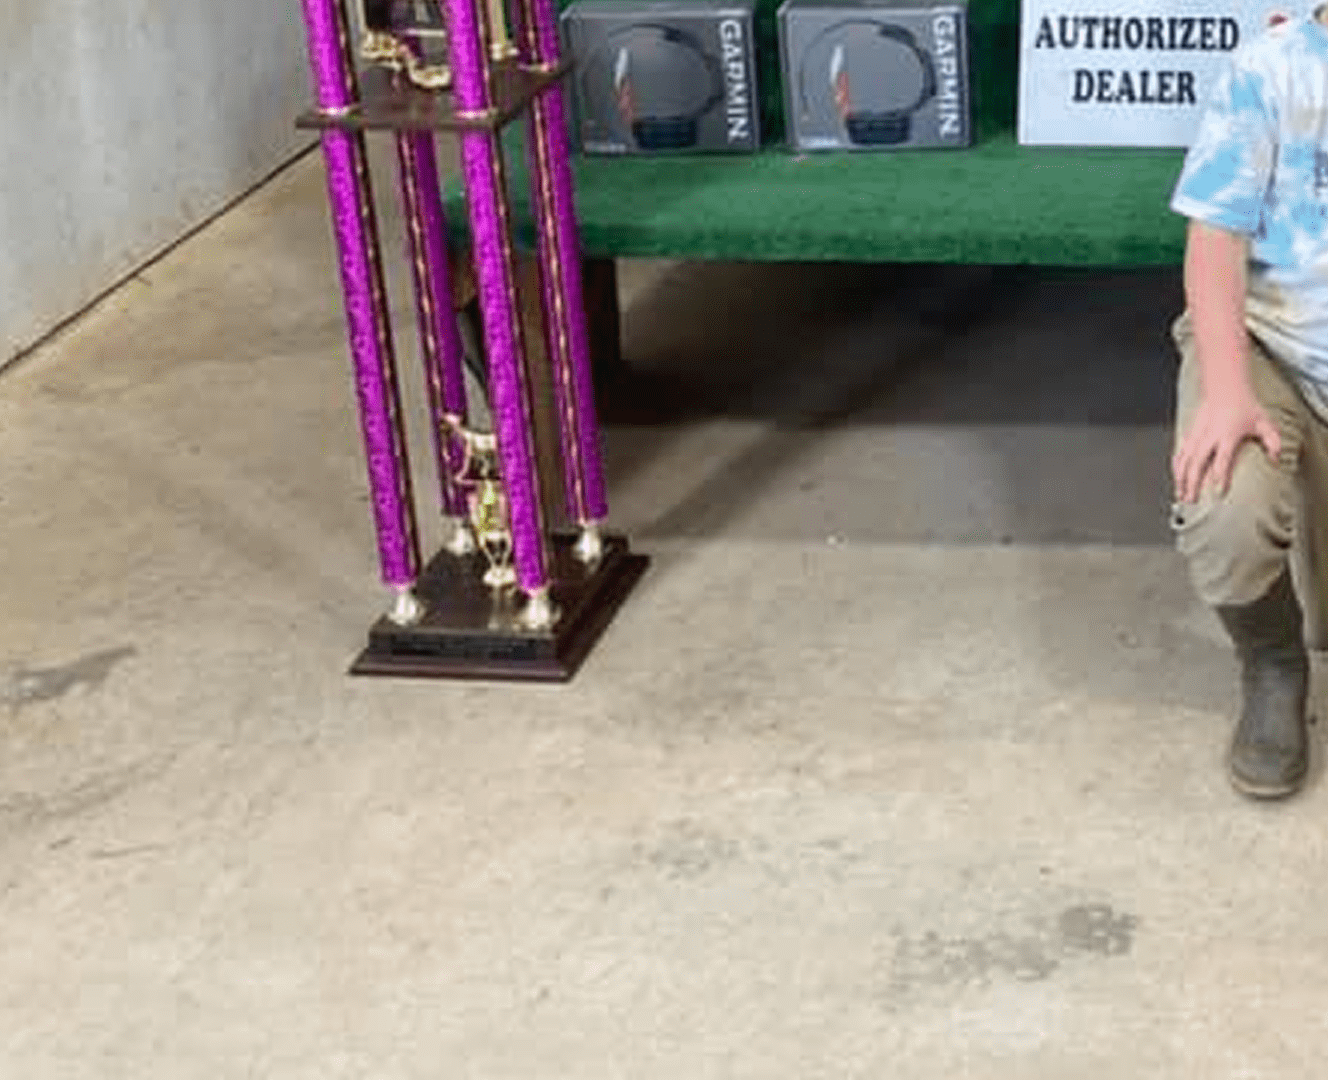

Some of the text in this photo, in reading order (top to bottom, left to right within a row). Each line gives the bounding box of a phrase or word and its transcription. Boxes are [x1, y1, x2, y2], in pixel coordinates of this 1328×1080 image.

[1035, 15, 1240, 52] AUTHORIZED
[719, 19, 750, 143] GARMIN
[931, 14, 961, 139] GARMIN
[1072, 69, 1197, 105] DEALER
